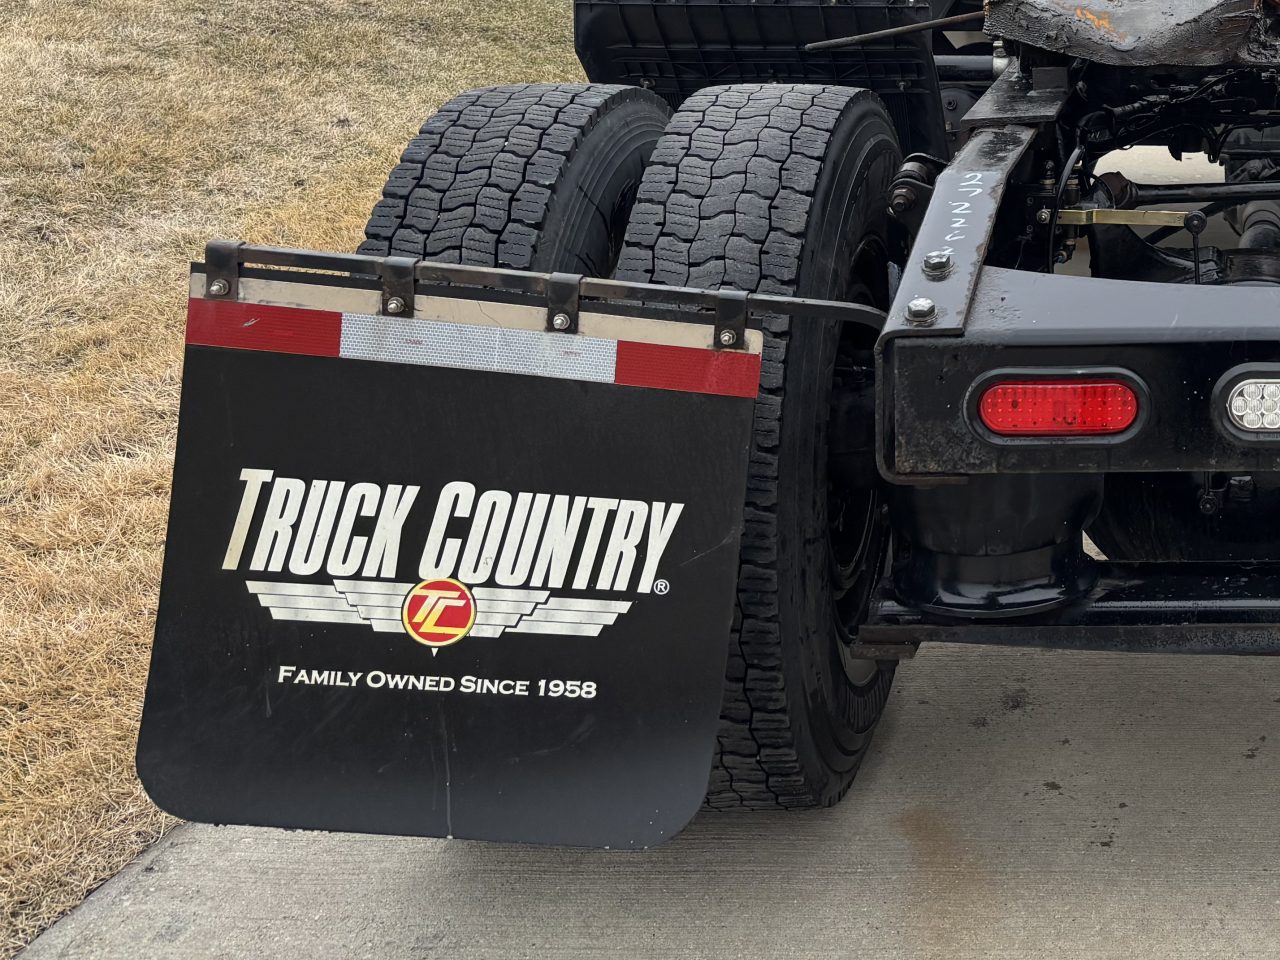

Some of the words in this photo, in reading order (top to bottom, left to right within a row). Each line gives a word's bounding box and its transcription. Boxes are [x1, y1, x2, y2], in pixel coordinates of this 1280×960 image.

[222, 468, 420, 578] TRUCK
[418, 481, 685, 594] COUNTRY
[537, 680, 598, 700] 1958
